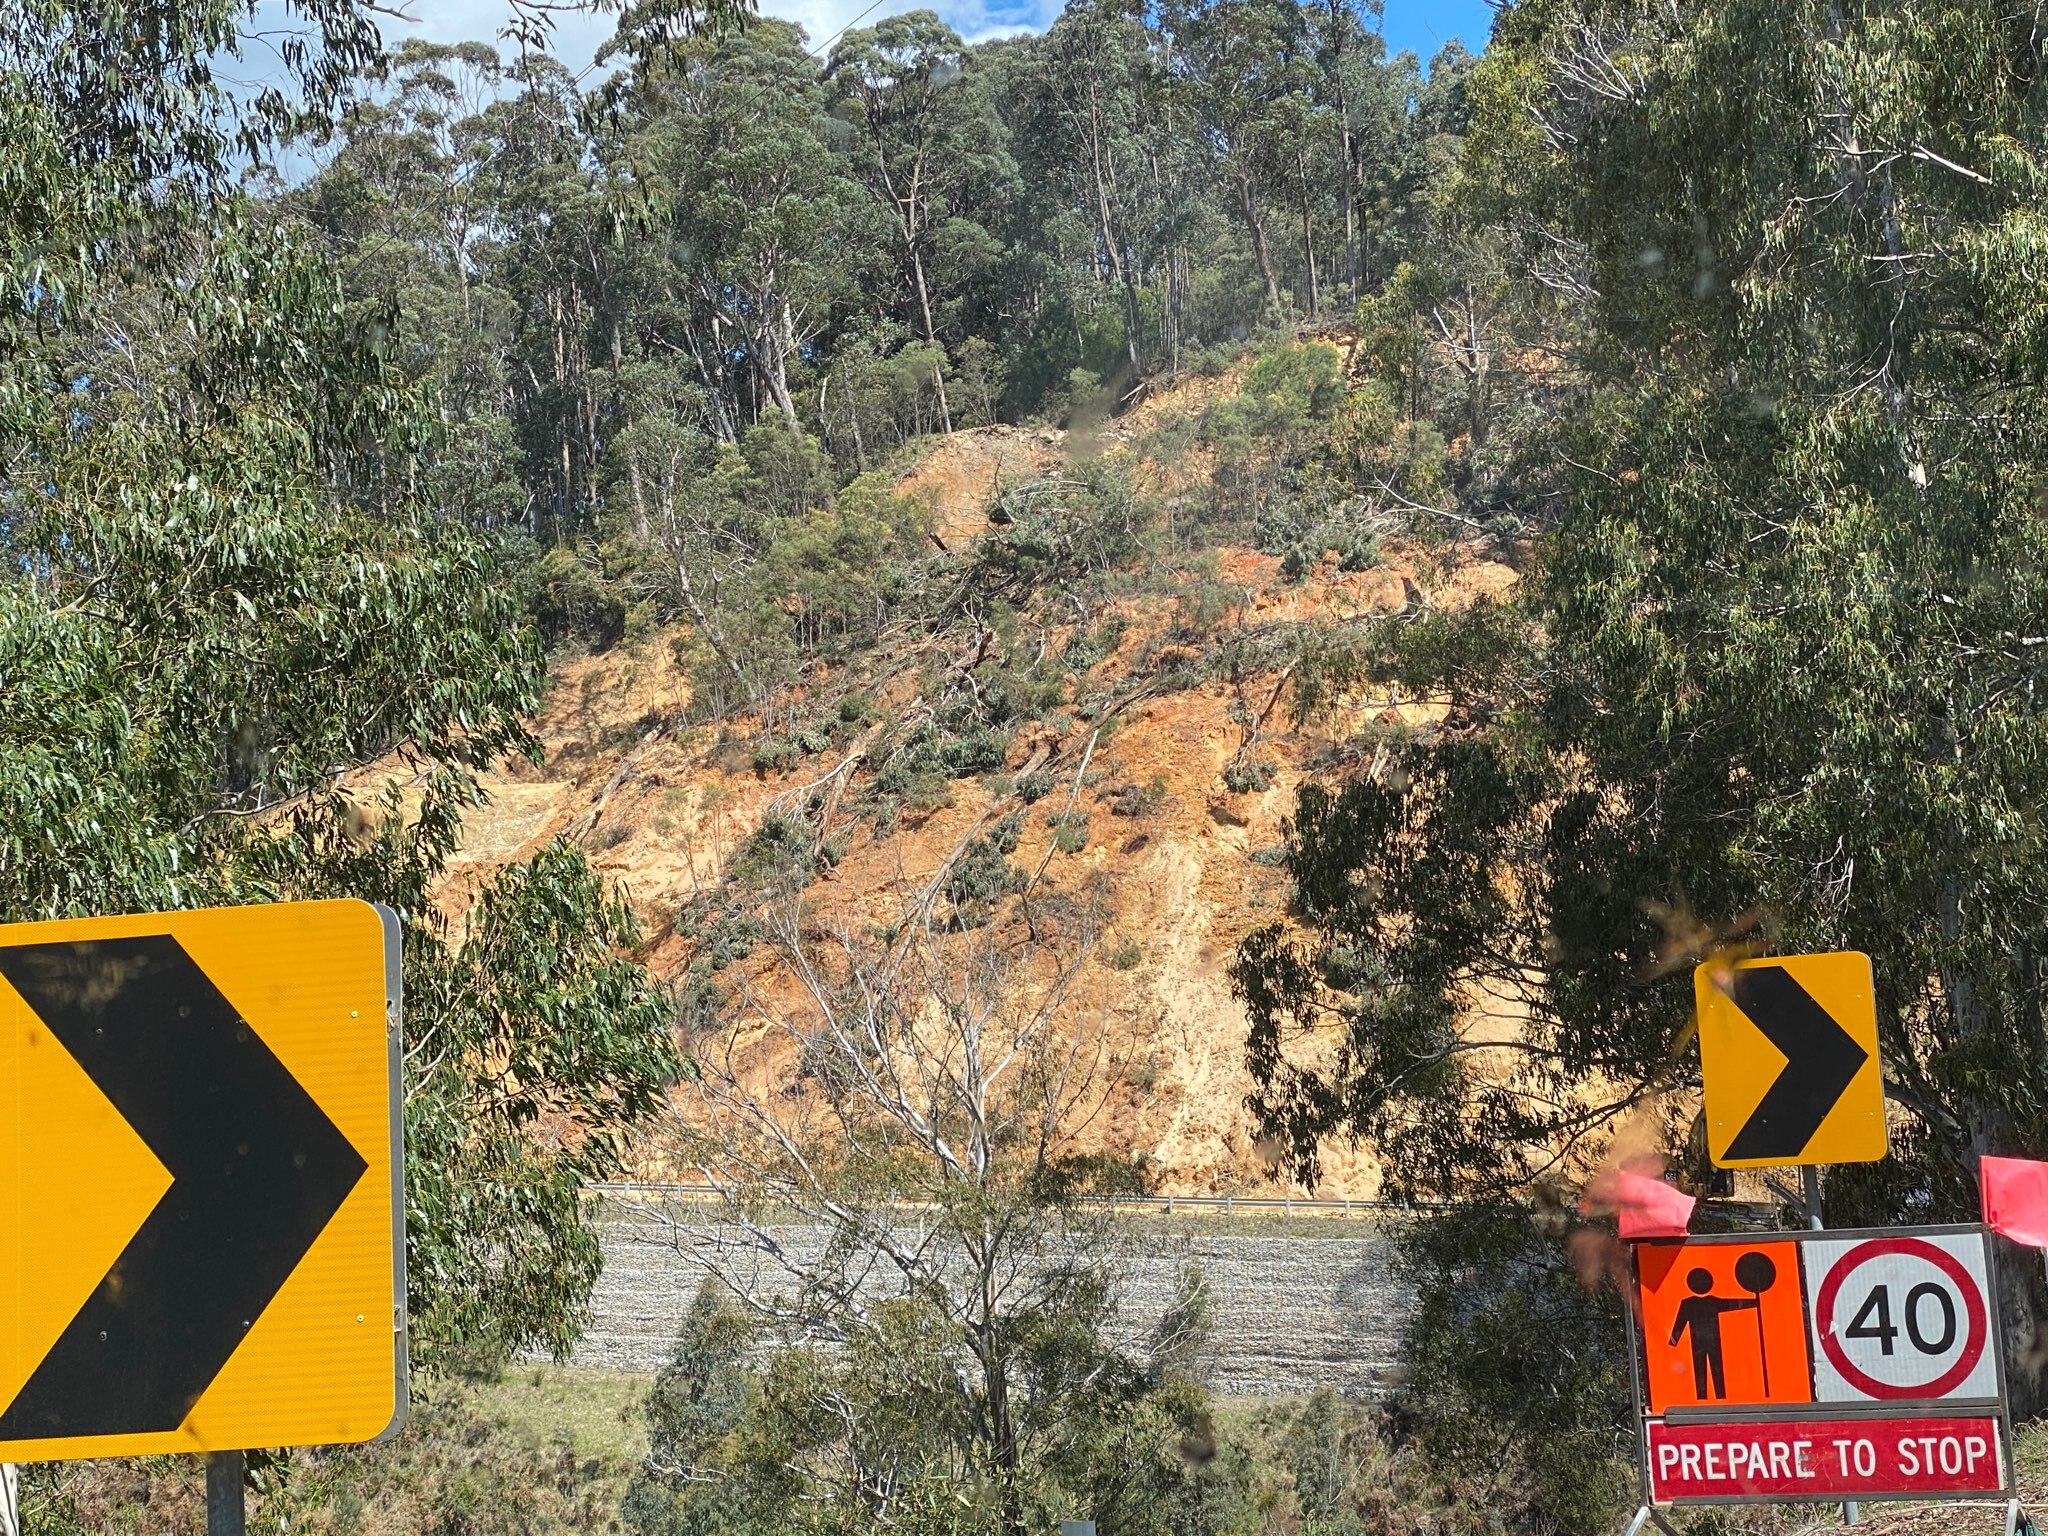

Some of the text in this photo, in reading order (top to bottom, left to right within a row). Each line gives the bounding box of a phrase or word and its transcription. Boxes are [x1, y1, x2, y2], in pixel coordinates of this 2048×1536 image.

[1845, 1282, 1956, 1355] 40
[1659, 1436, 1987, 1481] PREPARE TO STOP
